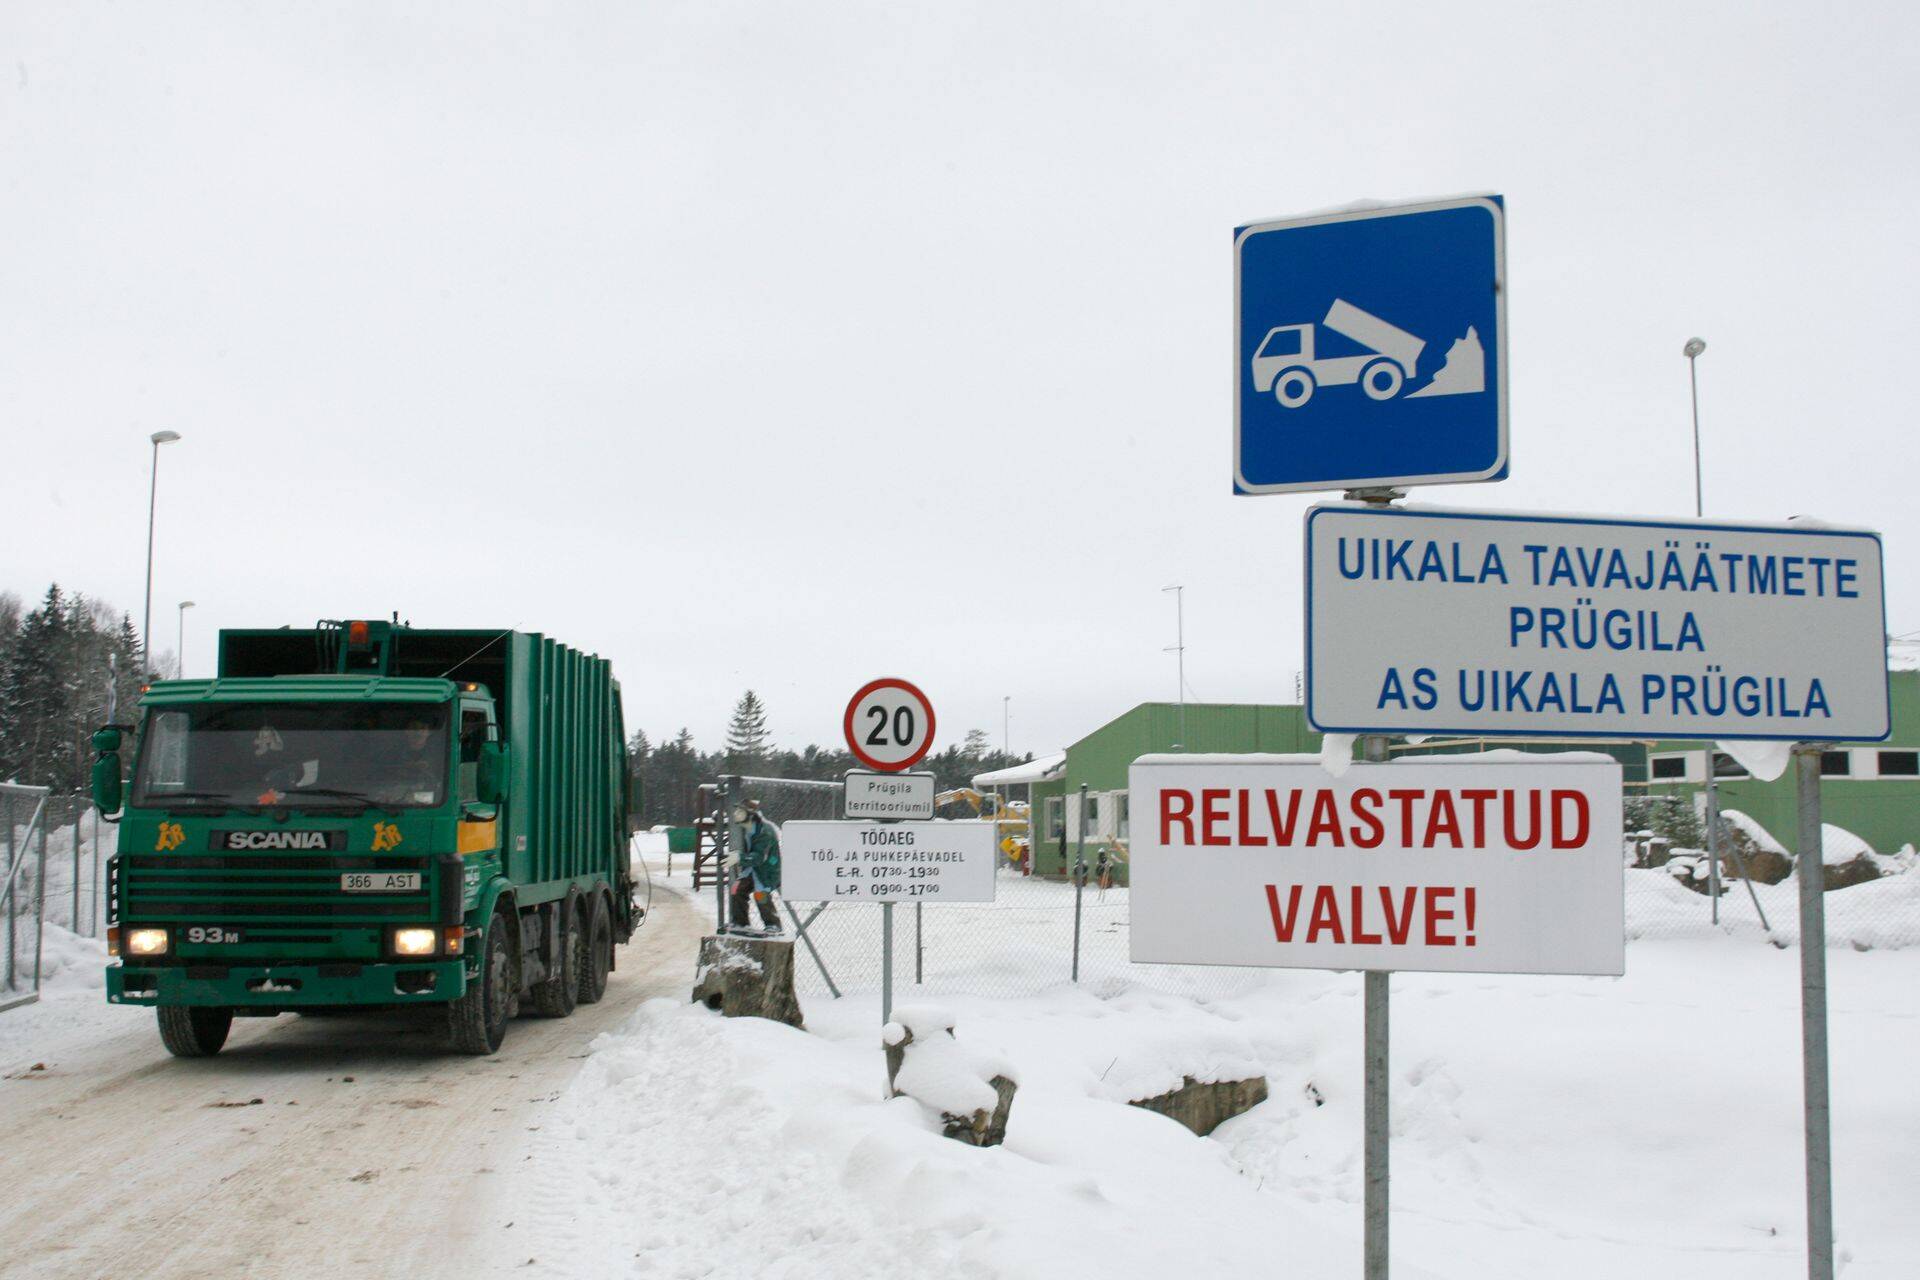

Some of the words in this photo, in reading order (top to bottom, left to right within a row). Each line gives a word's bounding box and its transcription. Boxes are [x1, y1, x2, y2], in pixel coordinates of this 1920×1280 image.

[1338, 537, 1510, 586] UIKALA
[1523, 539, 1861, 599] TAVAJÄÄTMETE
[1510, 598, 1706, 653] PRÜGILA
[1377, 666, 1439, 712] AS
[1459, 668, 1627, 716] UIKALA
[1642, 666, 1833, 719] PRÜGILA
[865, 705, 915, 747] 20
[868, 781, 913, 796] Prügila
[848, 801, 931, 813] territooriumil
[1160, 788, 1590, 849] RELVASTATUD
[228, 832, 327, 849] SCANIA
[860, 828, 915, 846] TÖÖAEG
[811, 848, 839, 862] TÖÖ-
[844, 850, 859, 862] JA
[863, 849, 965, 862] PUHKEPÄEVADEL
[347, 875, 372, 888] 366
[385, 874, 414, 888] AST
[1266, 884, 1477, 947] VALVE!
